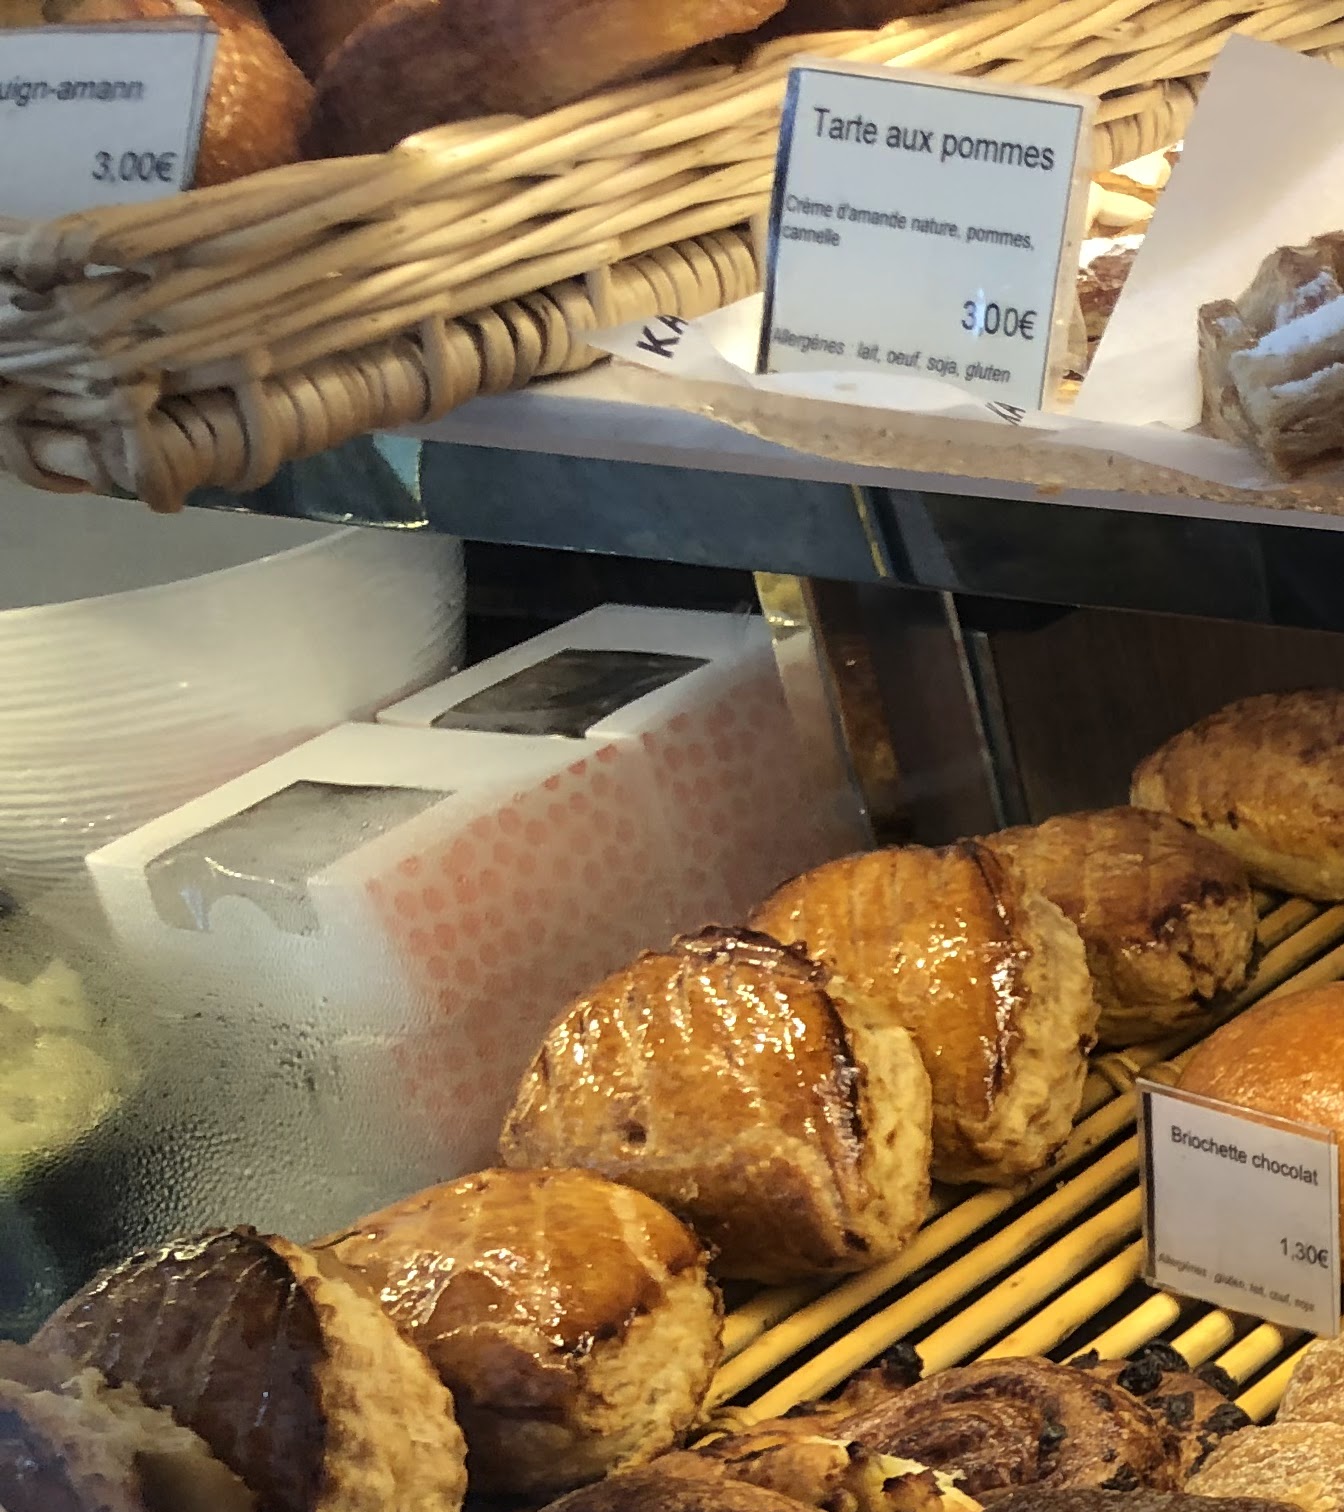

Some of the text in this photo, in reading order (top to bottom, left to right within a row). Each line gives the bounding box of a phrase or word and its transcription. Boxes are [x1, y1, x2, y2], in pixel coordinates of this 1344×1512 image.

[814, 106, 1055, 171] Tarte aux pommes
[965, 361, 1010, 383] gluten
[1171, 1125, 1318, 1186] Briochette chocolat
